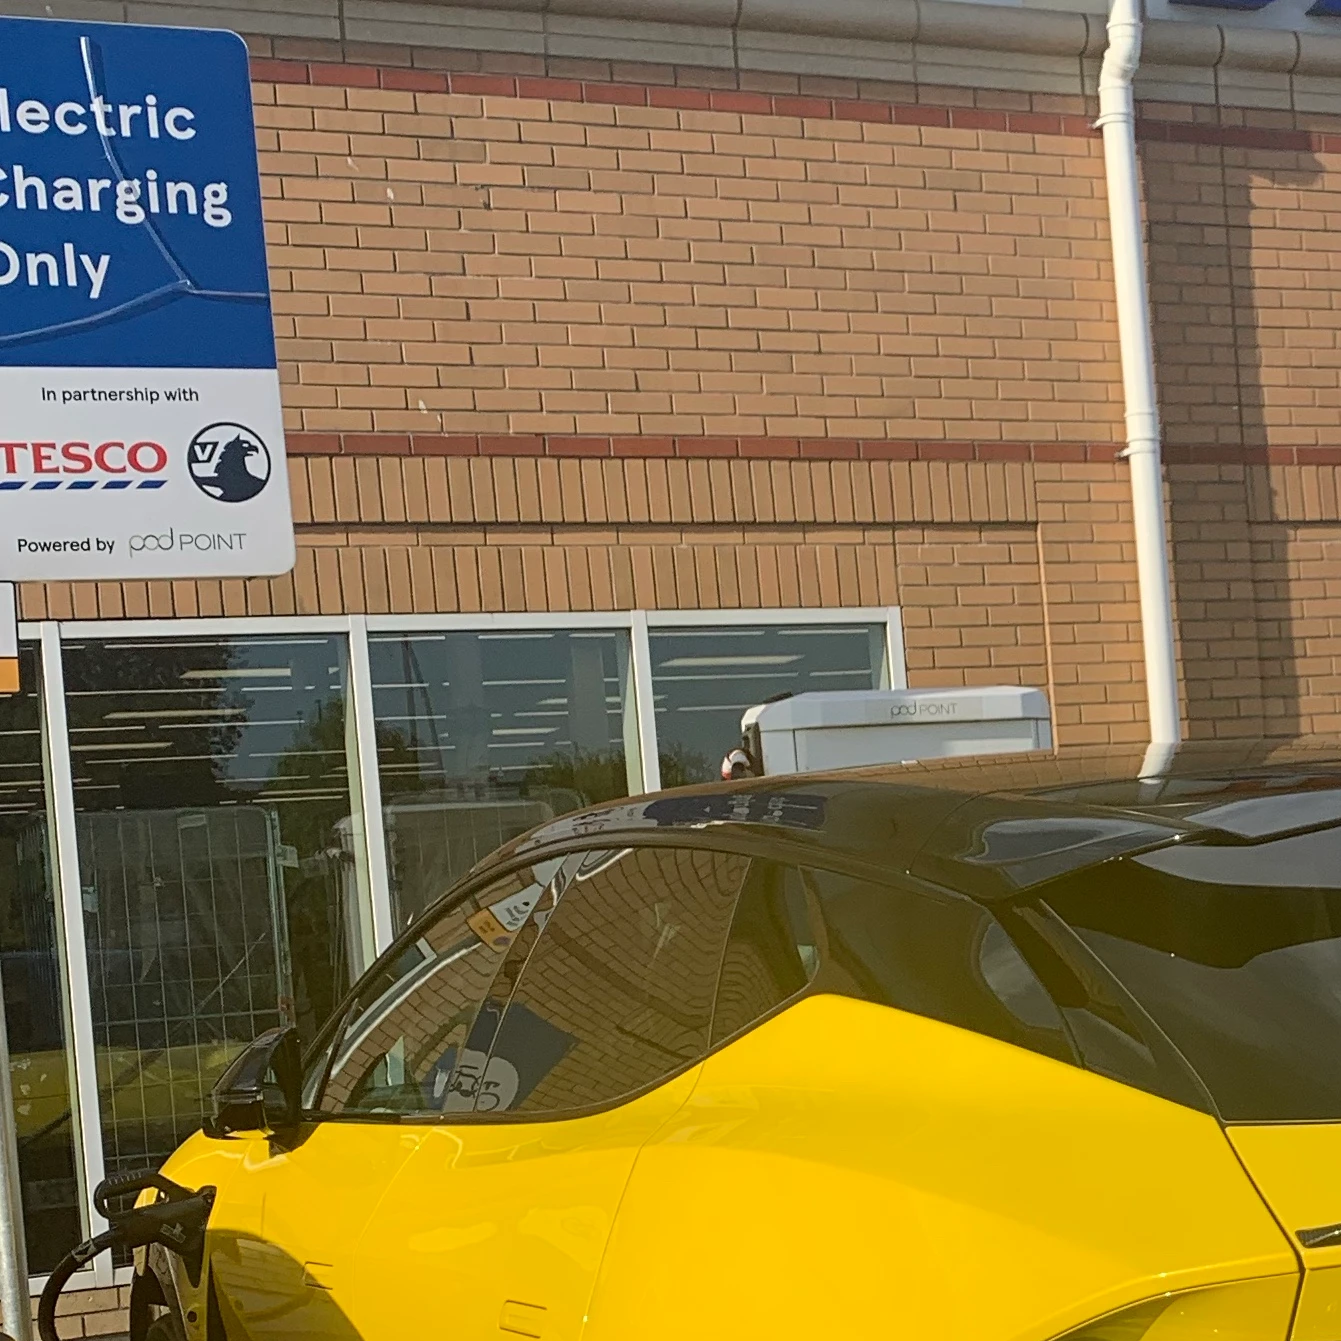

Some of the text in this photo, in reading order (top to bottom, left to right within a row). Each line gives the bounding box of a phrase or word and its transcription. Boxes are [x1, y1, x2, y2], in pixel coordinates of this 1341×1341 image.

[0, 87, 197, 140] lectric
[0, 164, 232, 228] harging
[41, 387, 200, 404] In partnership with
[0, 441, 168, 474] TESCO
[18, 538, 91, 553] Powered
[96, 538, 115, 555] by
[180, 533, 247, 550] POINT
[919, 703, 958, 716] POINT
